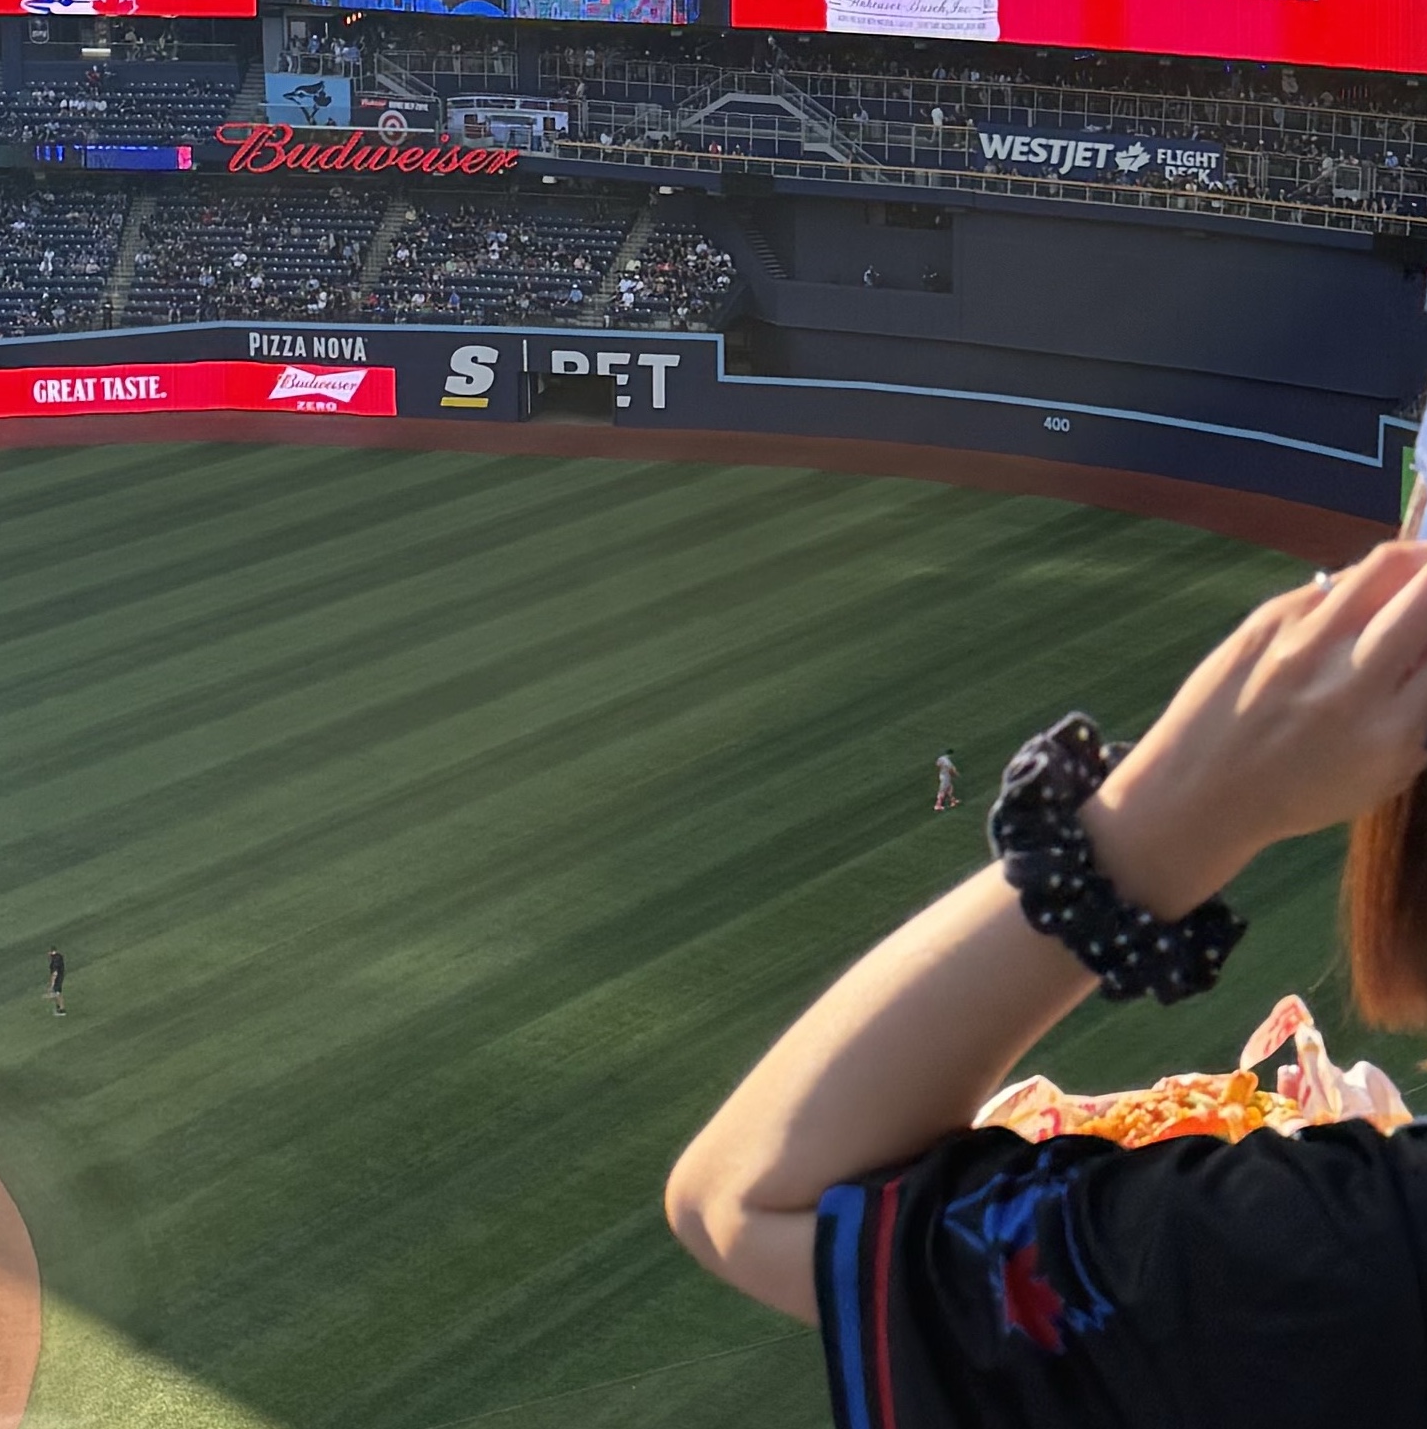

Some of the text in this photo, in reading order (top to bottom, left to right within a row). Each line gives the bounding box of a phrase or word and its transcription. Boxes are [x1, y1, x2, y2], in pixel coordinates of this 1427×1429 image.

[215, 121, 521, 175] Budweiser
[978, 132, 1220, 176] WESTJET FLIGHT
[248, 331, 367, 362] PIZZA NOVA
[444, 344, 500, 396] S
[33, 377, 97, 405] GREAT
[101, 375, 167, 402] TASTE.
[297, 401, 338, 411] ZERO
[1044, 416, 1070, 432] 400
